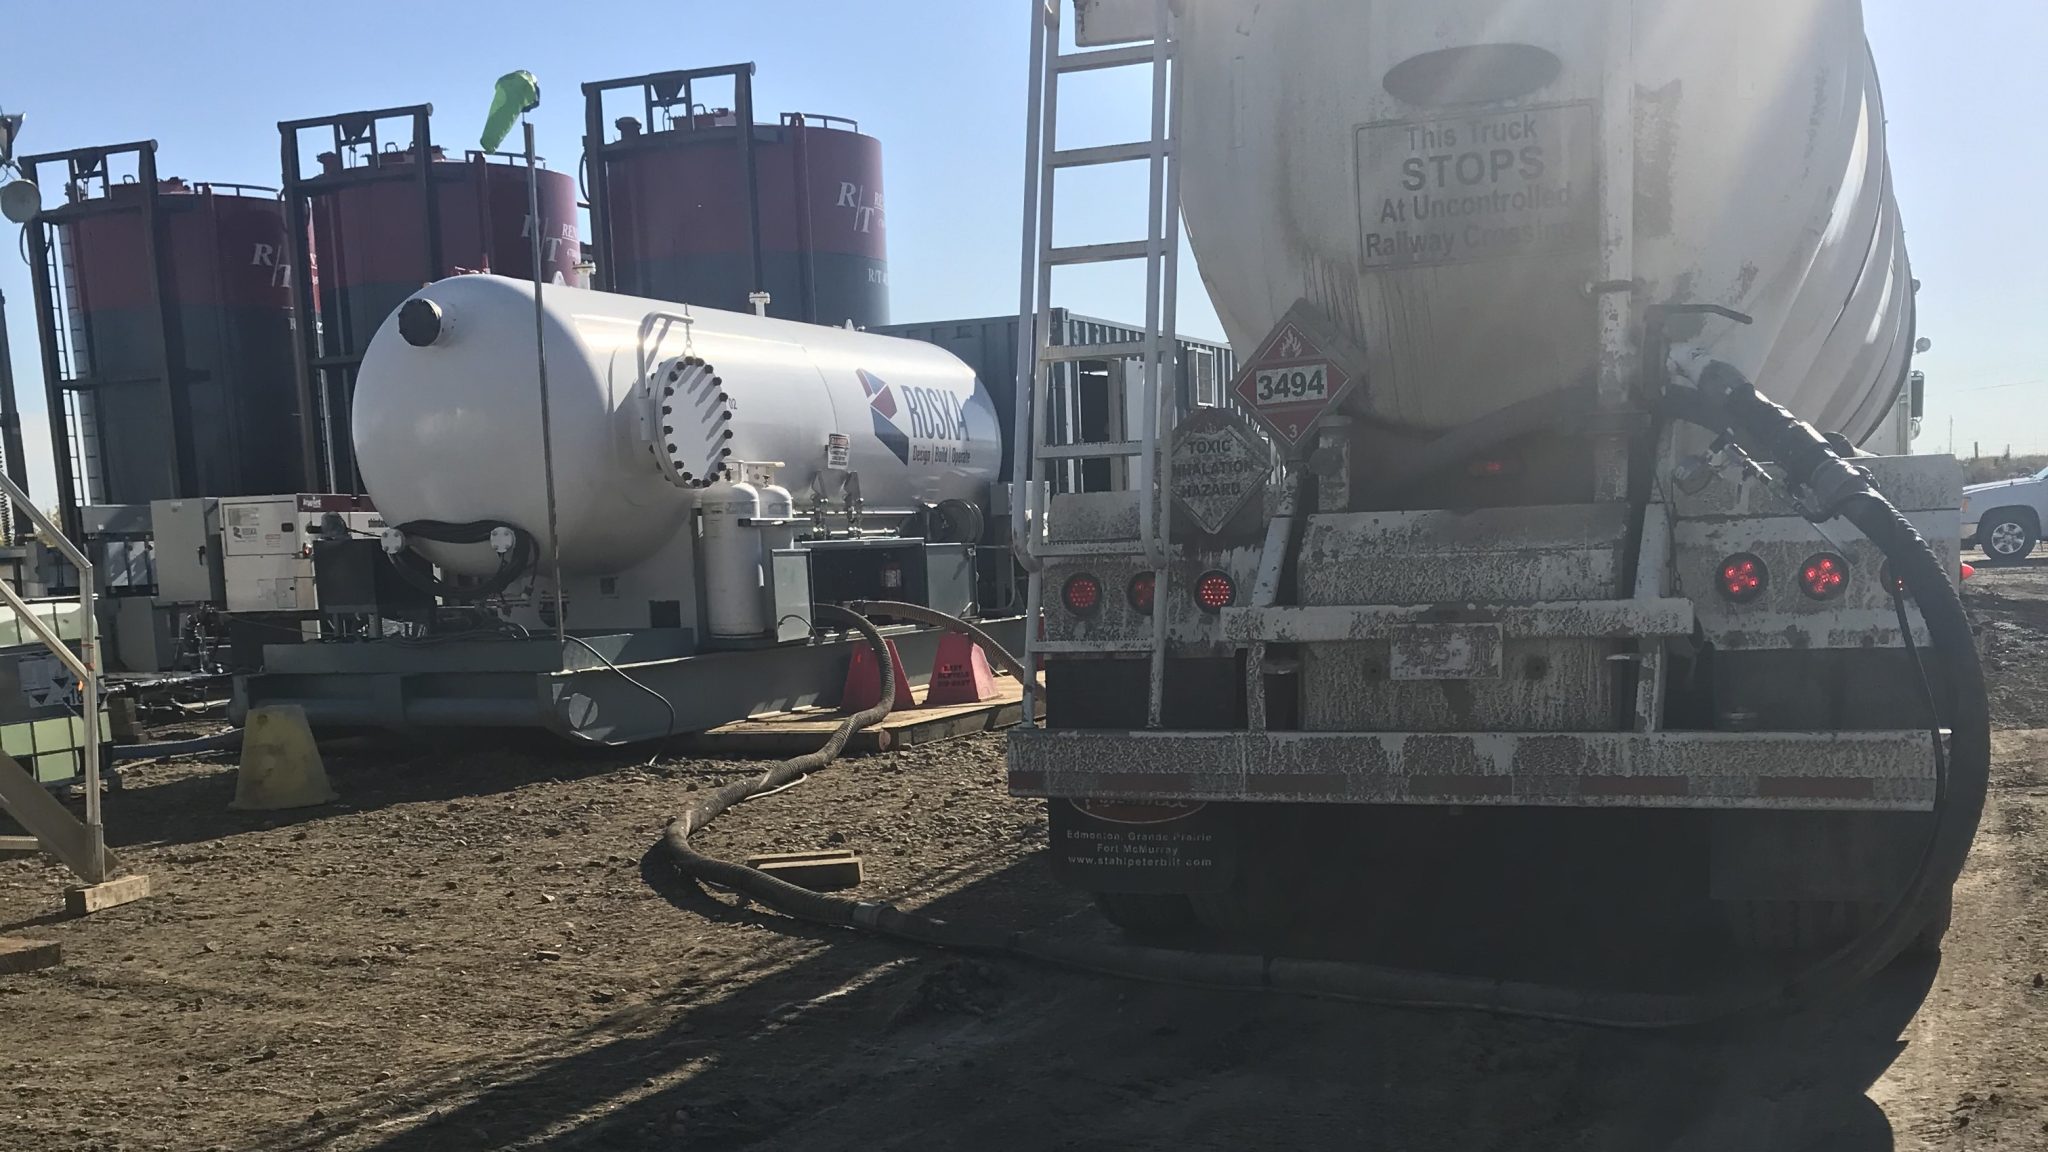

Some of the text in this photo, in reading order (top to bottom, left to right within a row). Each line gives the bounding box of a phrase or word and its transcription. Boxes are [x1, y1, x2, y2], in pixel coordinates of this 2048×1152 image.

[1404, 115, 1538, 151] This Truck
[1402, 147, 1545, 191] STOPS
[1380, 183, 1571, 223] At Uncontrolled
[1366, 232, 1455, 257] Railway
[1258, 369, 1325, 401] 3494
[901, 385, 970, 441] ROSKA
[1288, 424, 1298, 438] 3
[912, 444, 971, 467] Design Build Operate
[1188, 439, 1231, 454] TOXIC
[1171, 460, 1252, 476] NHALATION
[1182, 482, 1241, 498] HAZARD
[1096, 843, 1179, 857] Fort McMurray
